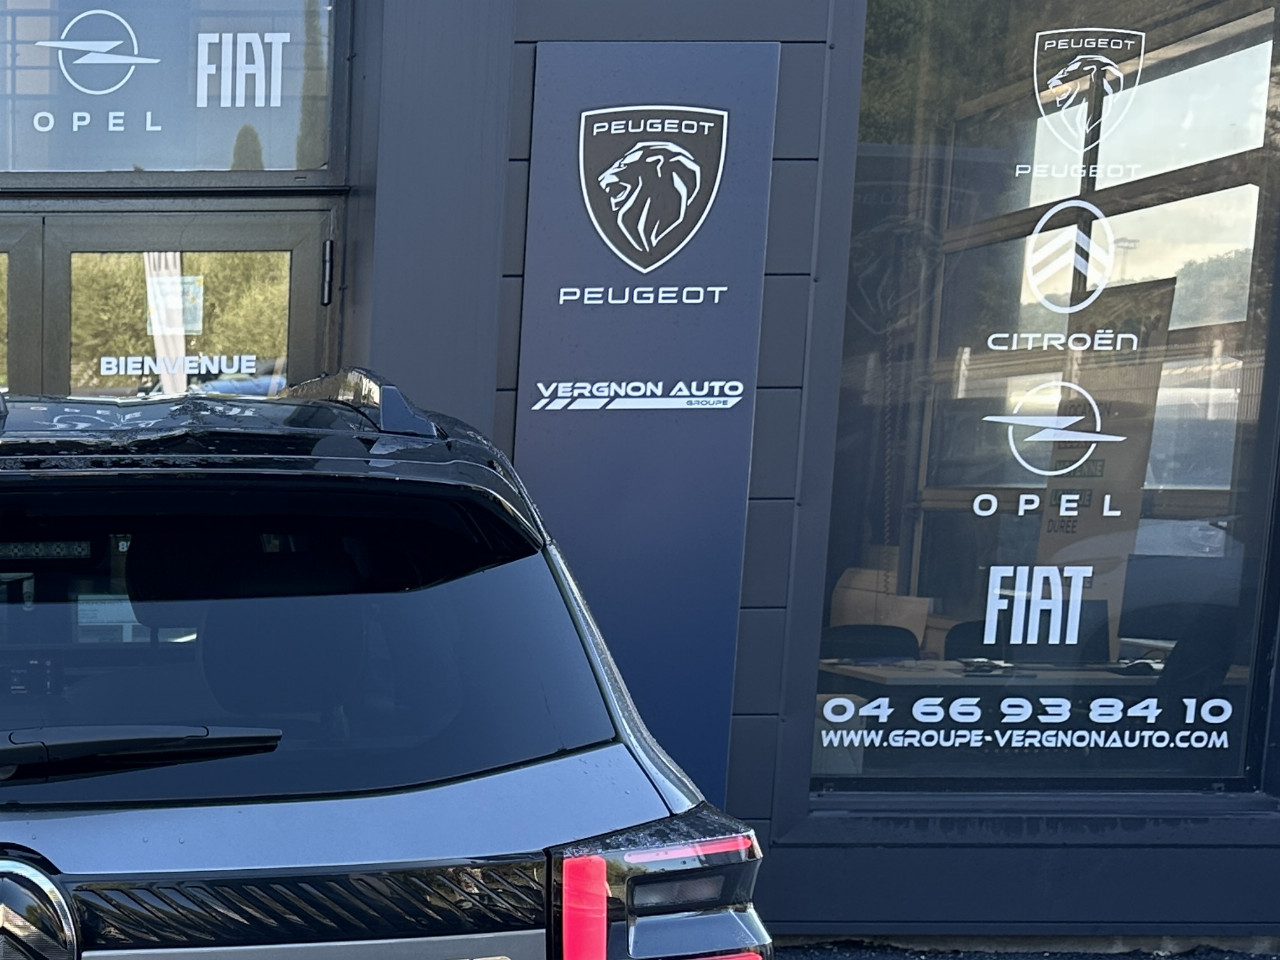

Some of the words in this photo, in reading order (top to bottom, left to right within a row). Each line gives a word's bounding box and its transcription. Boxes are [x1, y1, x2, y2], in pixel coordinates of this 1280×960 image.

[1043, 37, 1136, 51] PEUGEOT
[196, 32, 291, 108] FIAT
[32, 111, 162, 132] OPEL
[592, 119, 715, 136] PEUGEOT
[1014, 163, 1143, 179] PEUGEOT
[558, 286, 729, 305] PEUGEOT
[986, 329, 1139, 351] CITROËN
[100, 354, 257, 377] BIENVENUE
[536, 381, 663, 398] VERGNON
[669, 380, 745, 397] AUTO
[972, 494, 1123, 518] OPEL
[982, 565, 1094, 645] FIAT
[822, 697, 894, 723] 04
[911, 697, 983, 723] 66
[1001, 697, 1071, 723] 93
[1088, 697, 1163, 723] 84
[1183, 698, 1234, 724] 10
[821, 729, 1230, 749] WWW.GROUPE-VERGNONAUTO.COM
